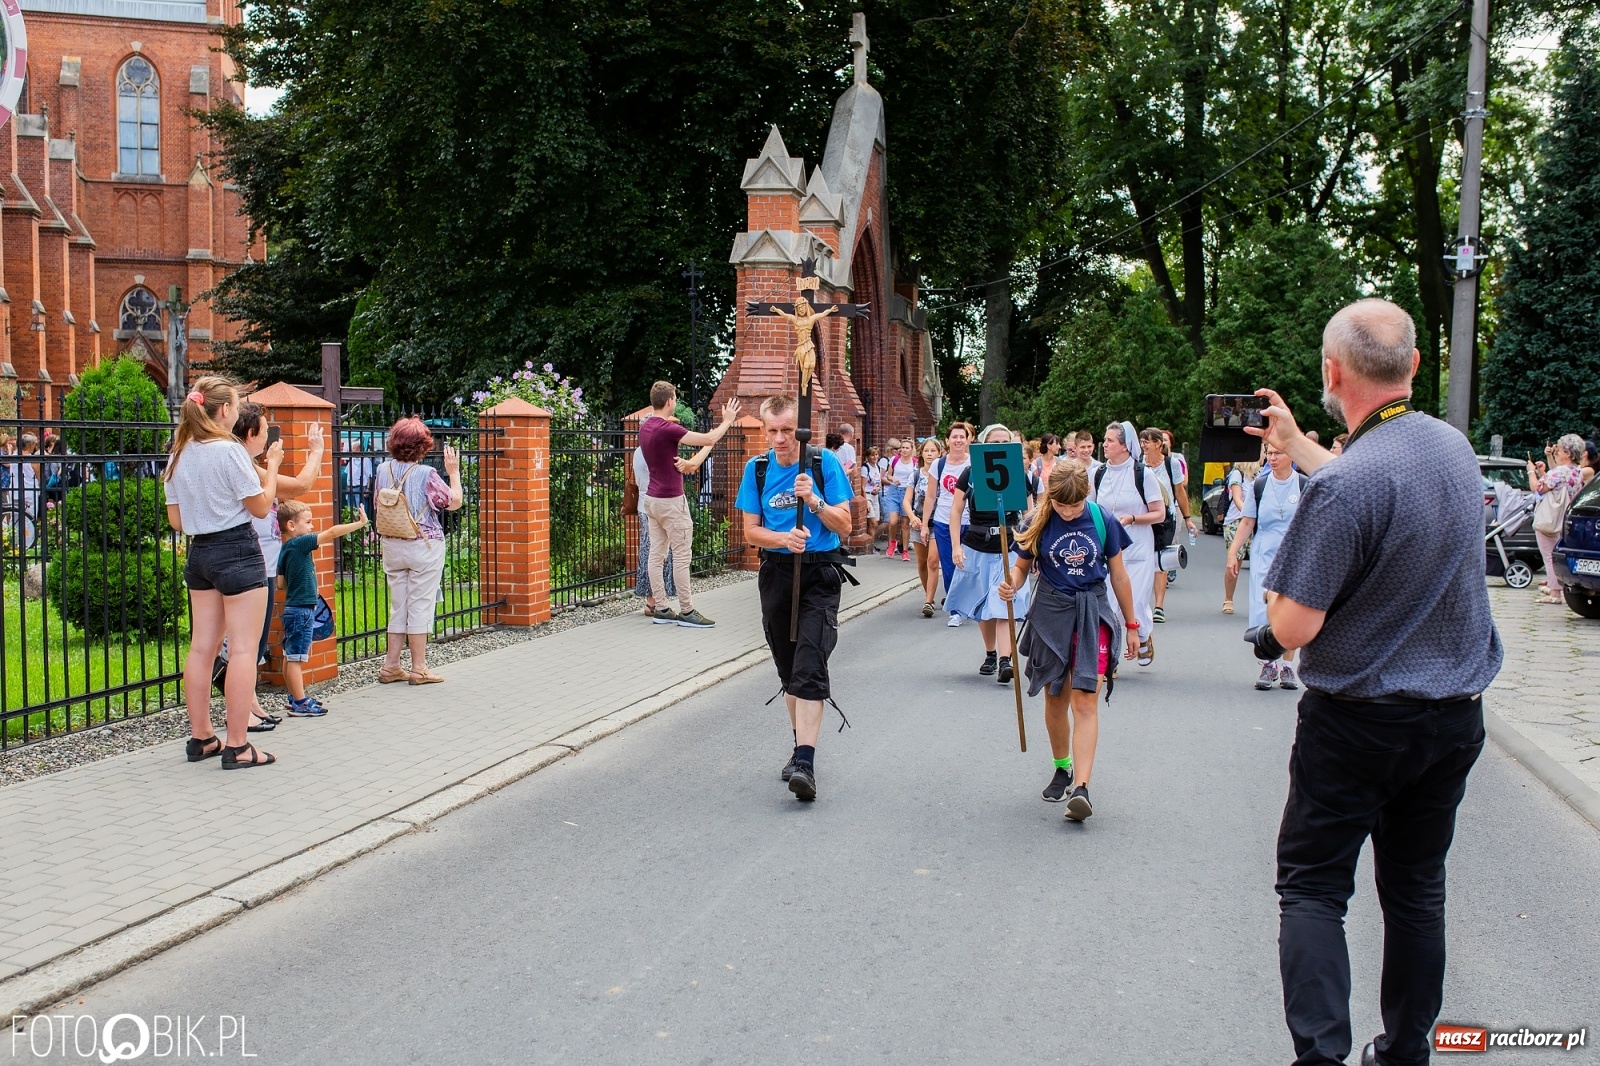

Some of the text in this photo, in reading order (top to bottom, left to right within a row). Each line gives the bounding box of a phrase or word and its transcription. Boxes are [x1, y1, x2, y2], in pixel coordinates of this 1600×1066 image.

[1380, 405, 1406, 420] Nikon
[983, 450, 1010, 492] 5
[1067, 568, 1085, 576] ZHR
[1578, 559, 1593, 572] SRC
